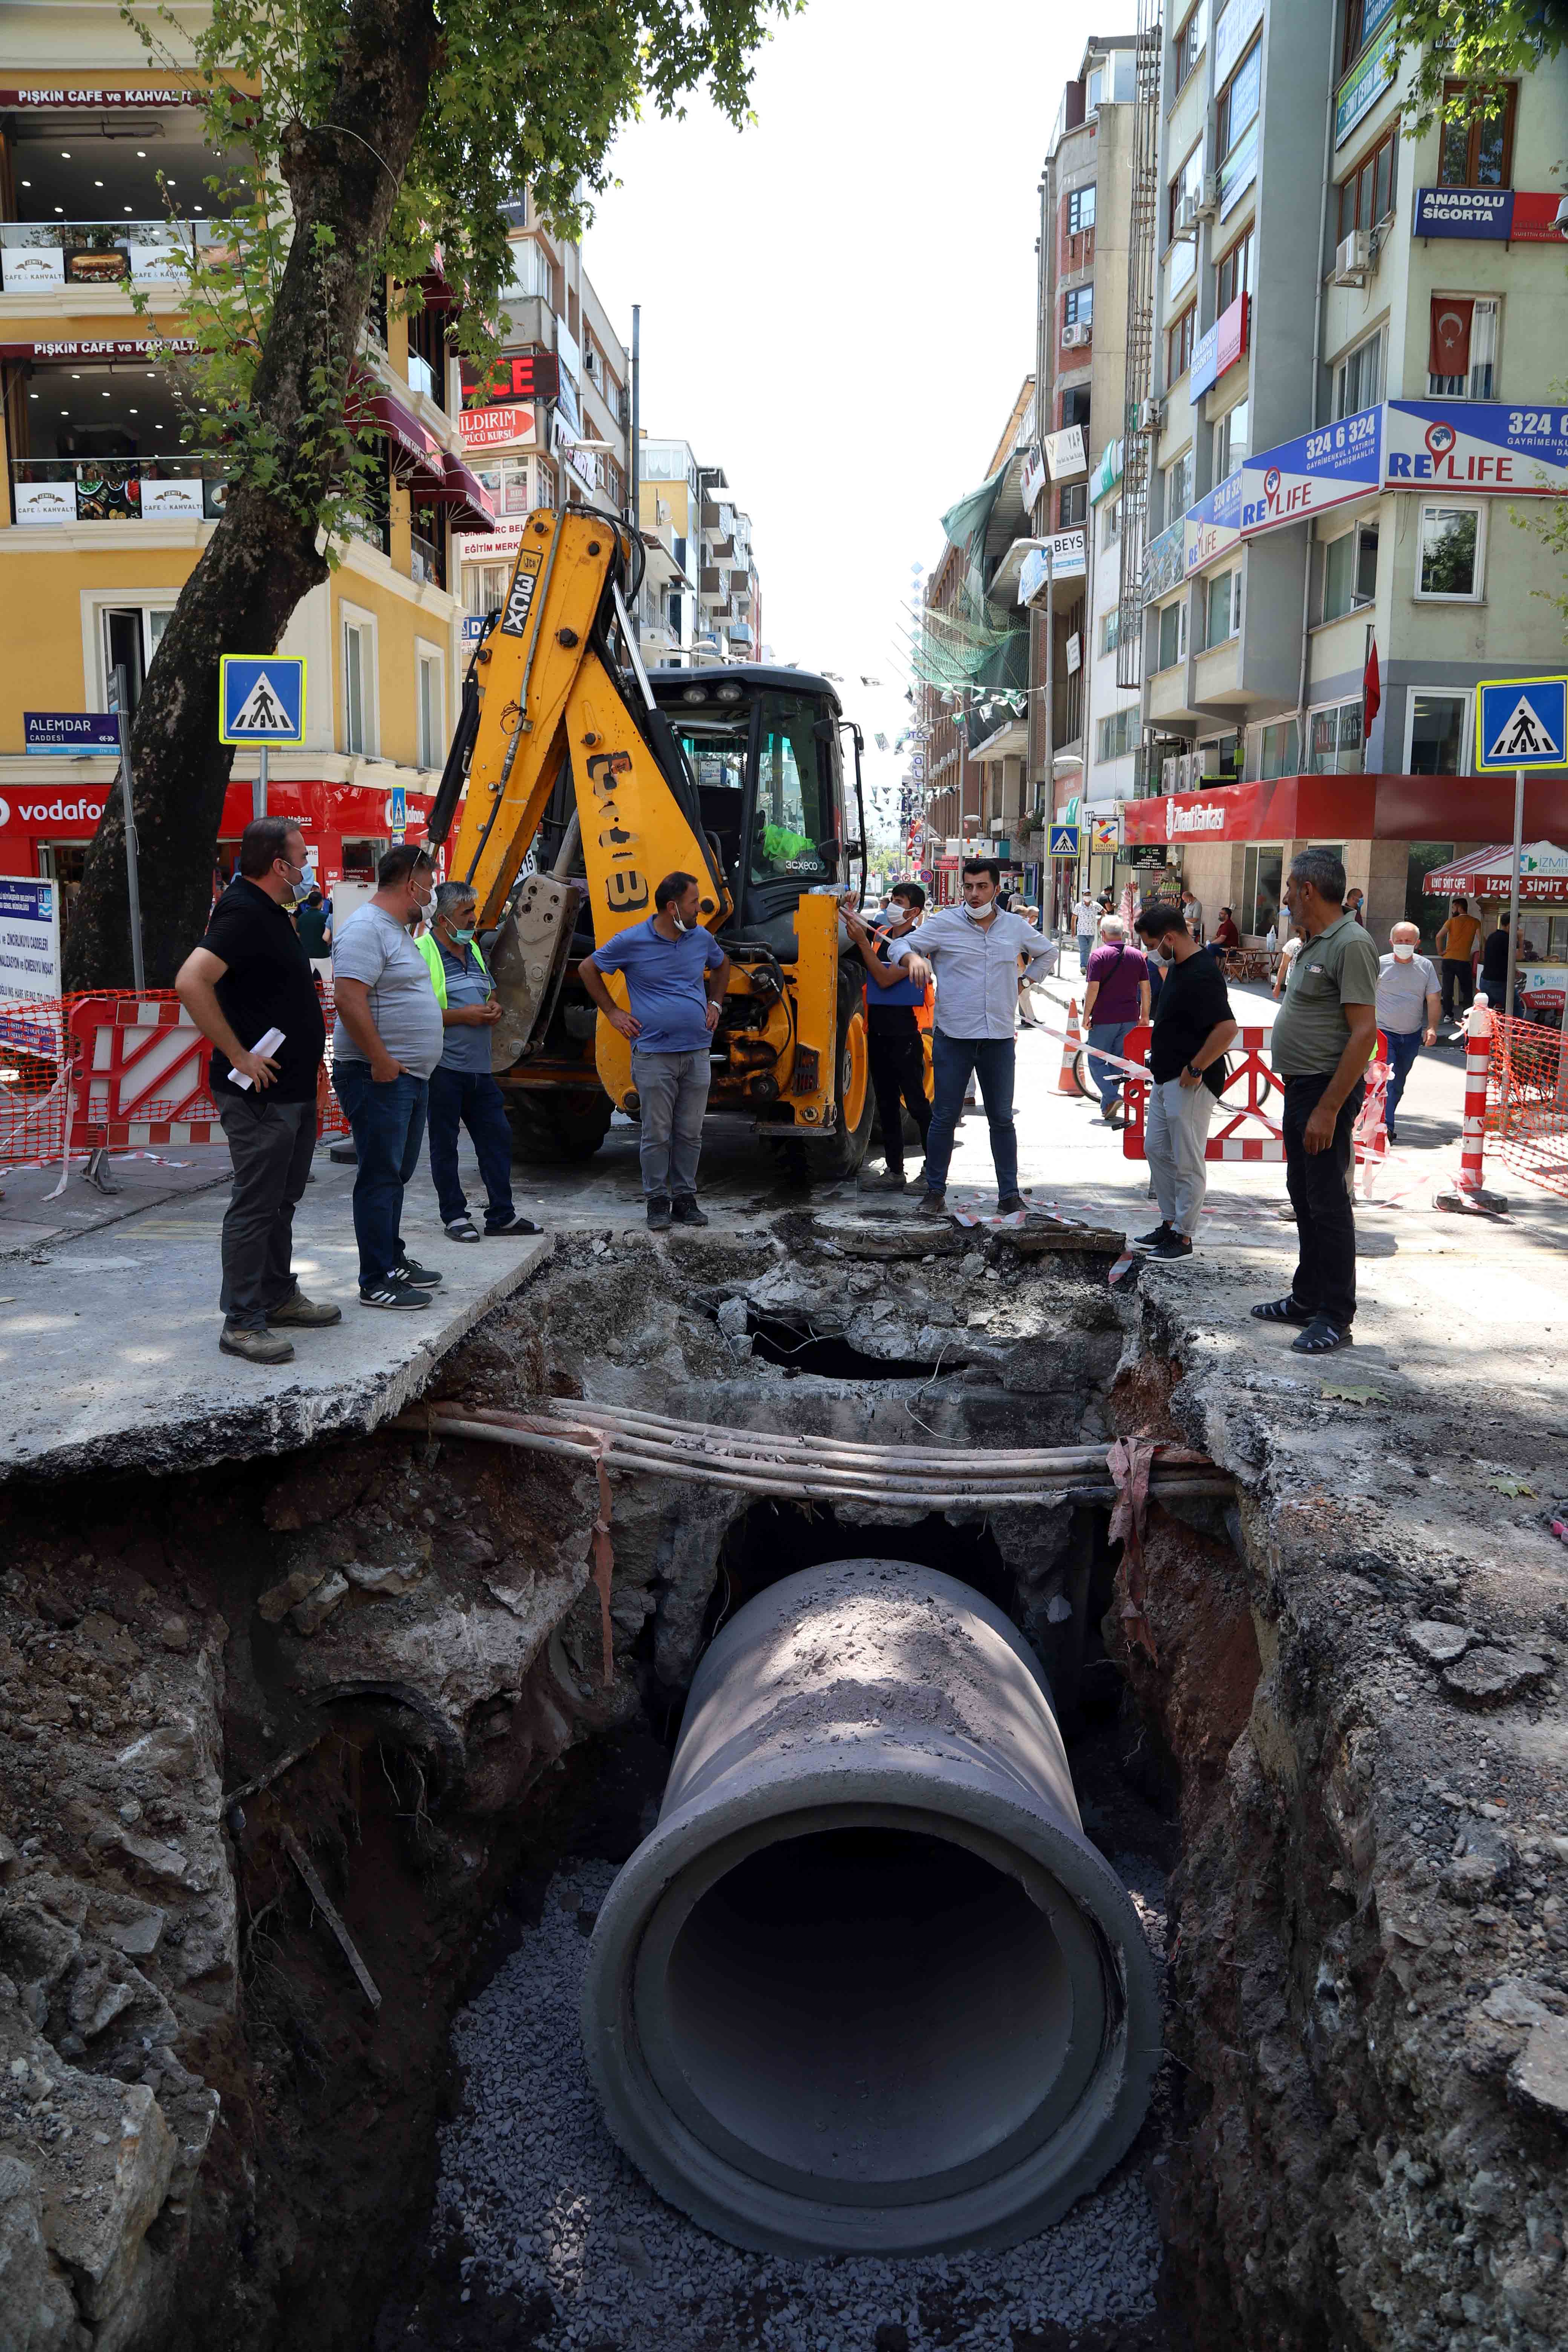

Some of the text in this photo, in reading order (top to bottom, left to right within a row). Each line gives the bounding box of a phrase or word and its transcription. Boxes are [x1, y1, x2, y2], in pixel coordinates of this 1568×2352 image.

[18, 90, 63, 104] PİŞKİN
[68, 90, 101, 102] CAFE
[106, 93, 121, 101] ve
[1424, 193, 1504, 207] ANADOLU
[1423, 205, 1493, 221] SİGORTA
[34, 342, 77, 356] PİŞKİN
[81, 343, 114, 353] CAFE
[1508, 412, 1552, 435] 324
[488, 429, 514, 441] KURSU
[1067, 431, 1080, 449] YAP
[1306, 413, 1375, 459] 324 6 324
[1306, 450, 1346, 471] GAYRİMENKUL
[1352, 438, 1375, 453] YATIRIM
[1335, 448, 1375, 469] DANIŞMANLIK
[1214, 488, 1226, 513] 324
[1226, 484, 1231, 502] 6
[465, 542, 521, 554] EĞİTİM MERK
[1054, 536, 1083, 552] BEYS
[504, 574, 534, 630] 3CX
[30, 719, 91, 732] ALEMDAR
[1527, 879, 1562, 892] SİMİT
[41, 957, 54, 978] İNŞAAT
